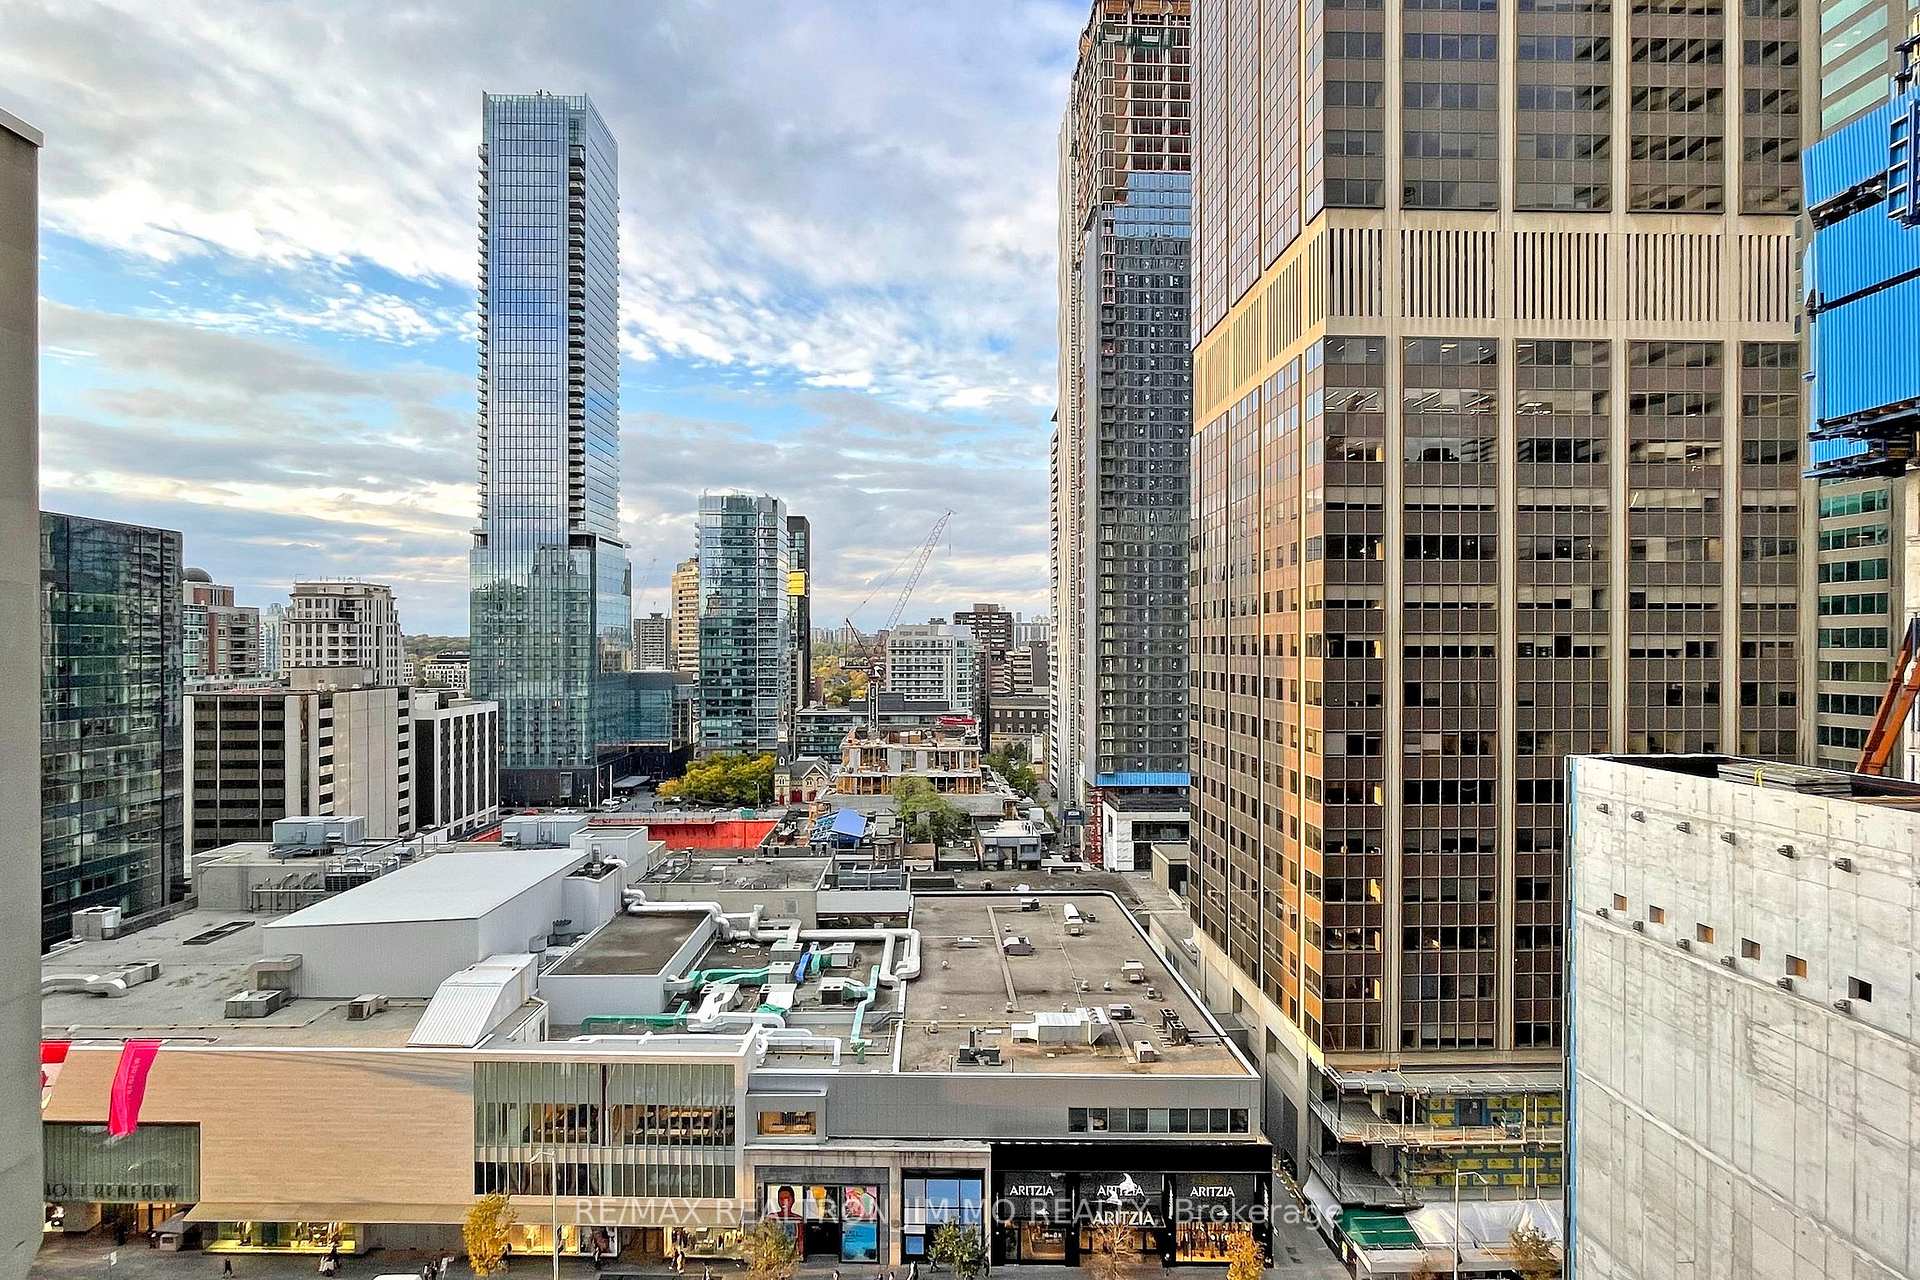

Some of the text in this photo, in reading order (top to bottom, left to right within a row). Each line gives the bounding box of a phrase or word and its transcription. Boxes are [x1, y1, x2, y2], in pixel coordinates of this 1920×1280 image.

[1009, 1185, 1055, 1197] ARITZIA
[1190, 1186, 1235, 1198] ARITZIA
[1092, 1210, 1156, 1226] ARITZIA
